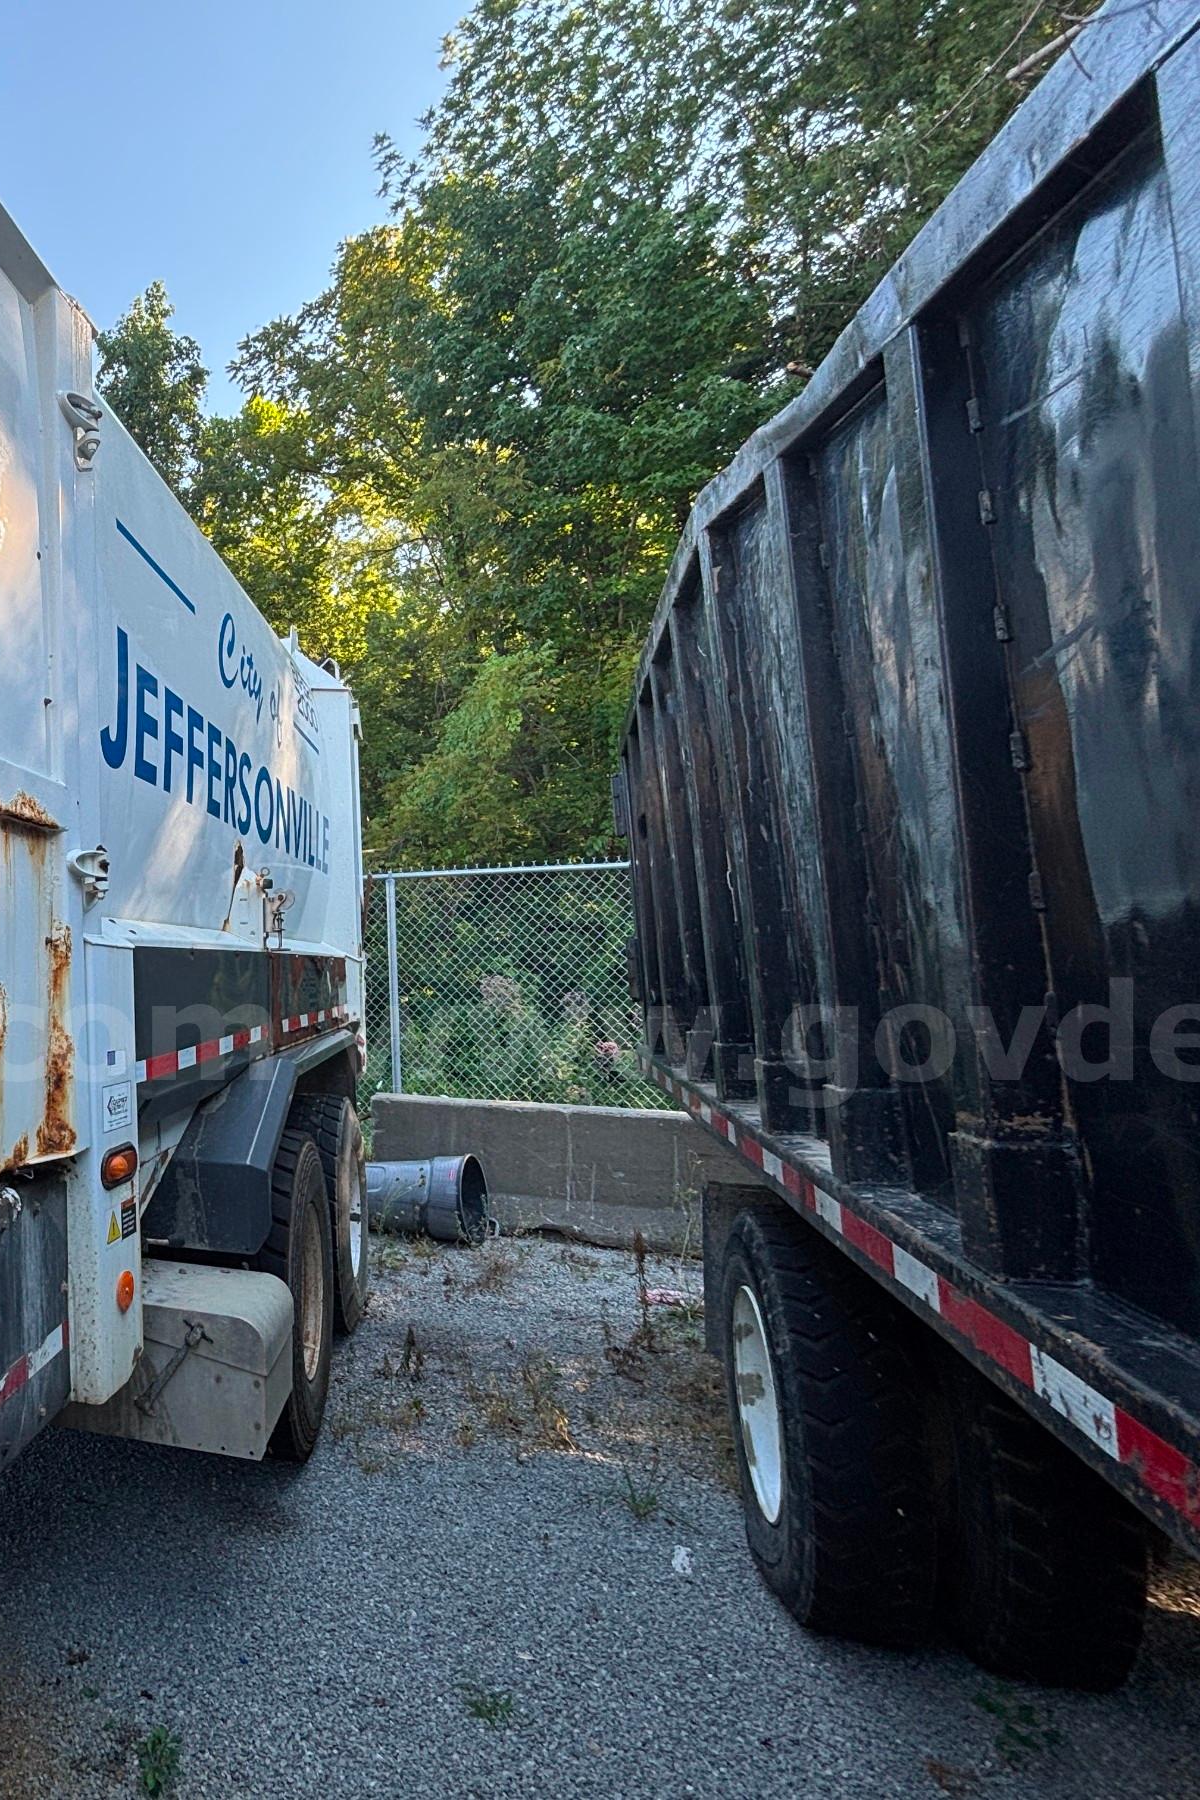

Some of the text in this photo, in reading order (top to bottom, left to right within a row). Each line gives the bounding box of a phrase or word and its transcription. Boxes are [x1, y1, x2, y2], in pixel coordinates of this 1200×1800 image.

[100, 625, 329, 874] JEFFERSONVILLE
[218, 612, 282, 749] City of
